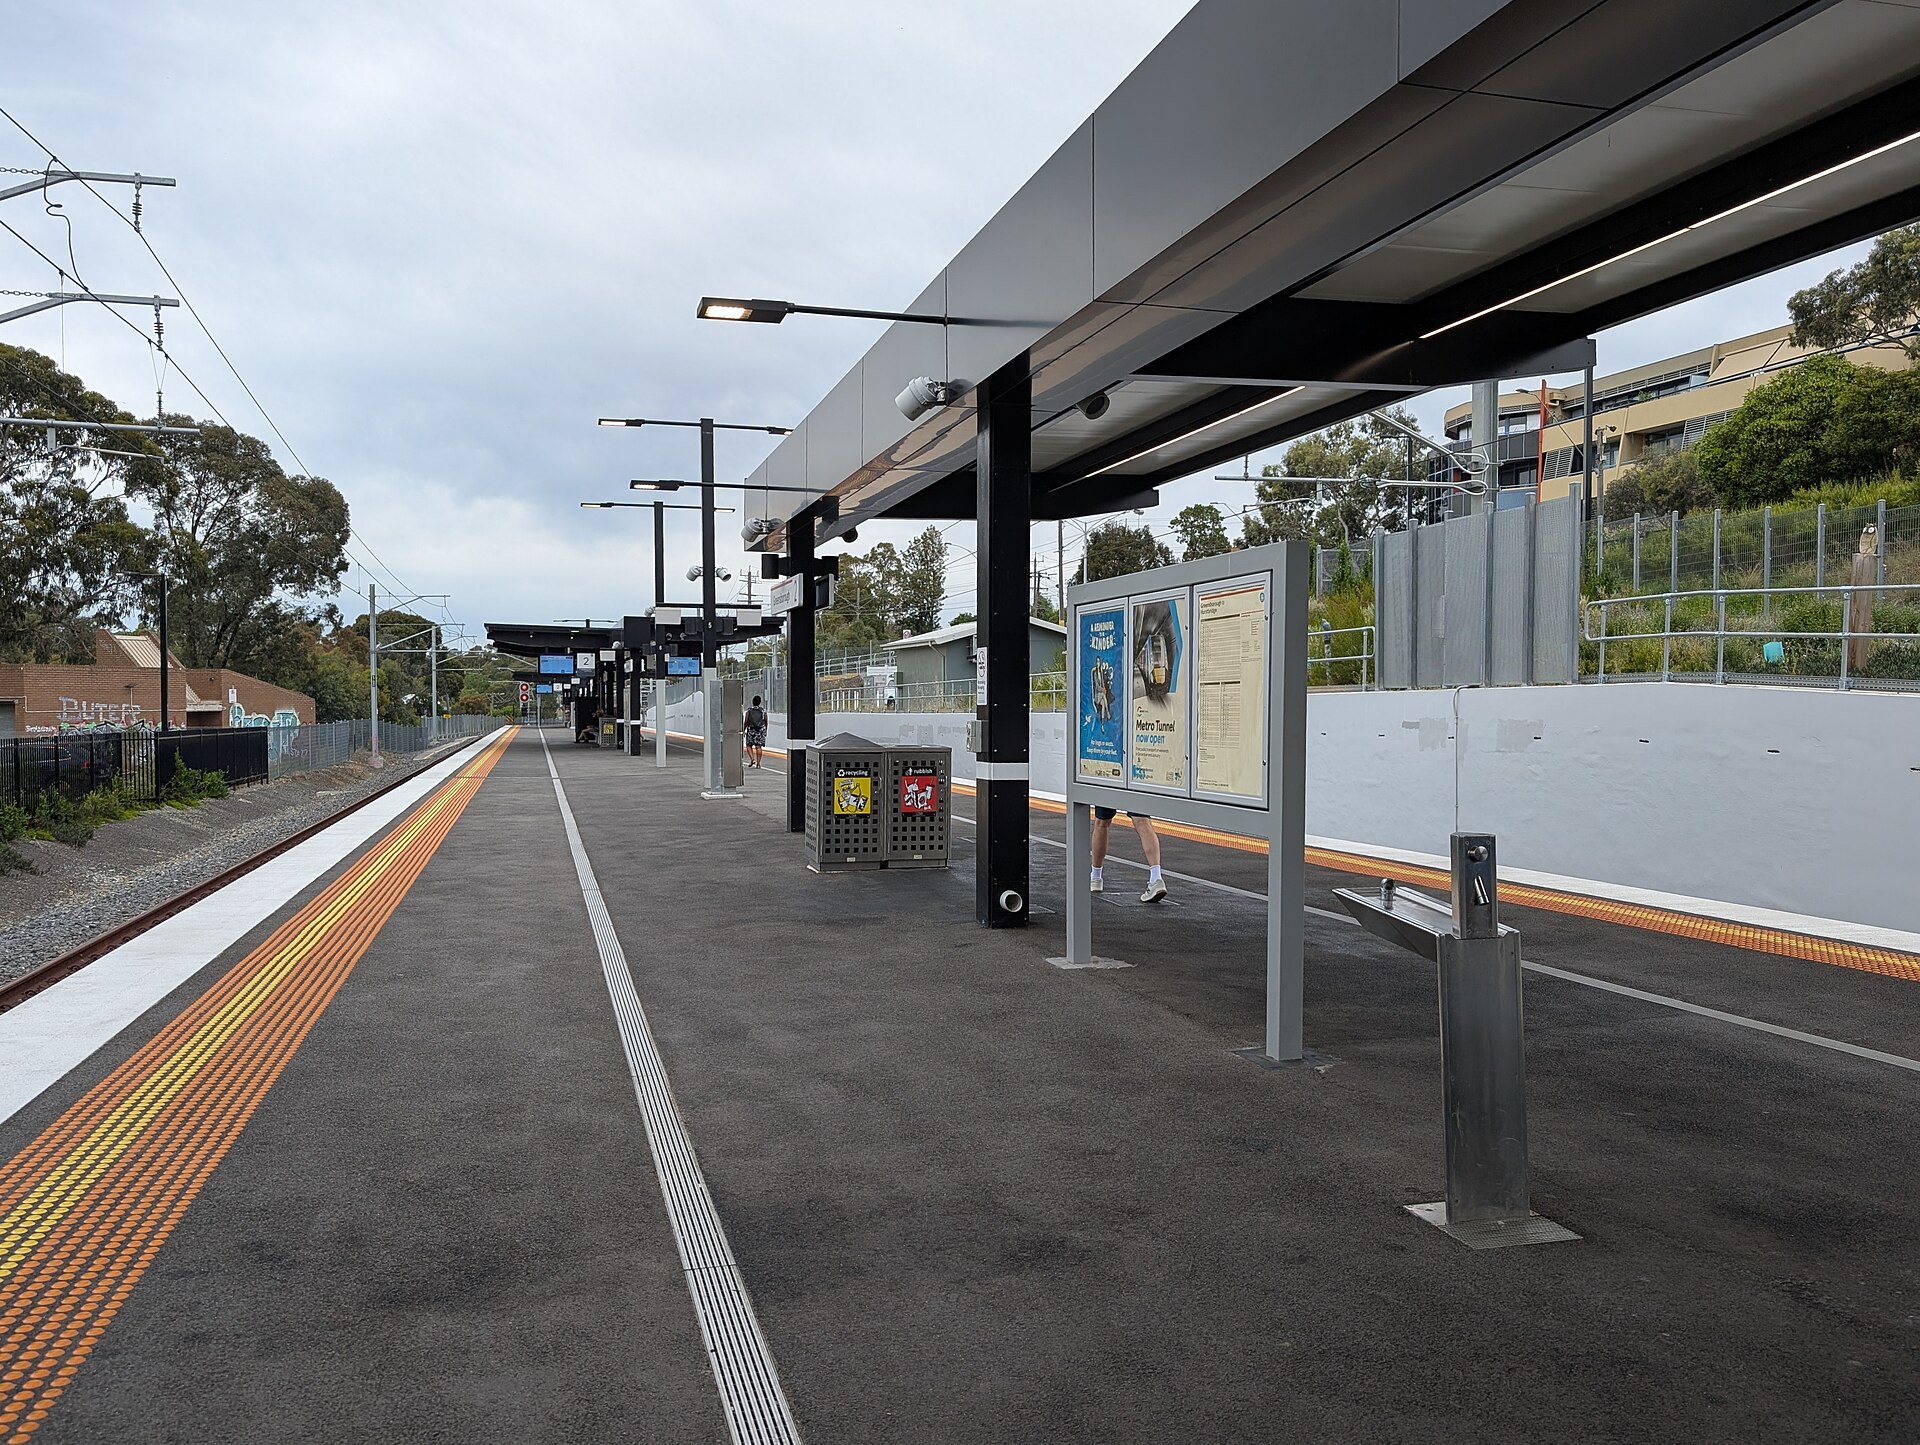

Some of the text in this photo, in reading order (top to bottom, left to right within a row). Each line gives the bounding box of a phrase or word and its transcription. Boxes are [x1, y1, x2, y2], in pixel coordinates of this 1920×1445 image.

[794, 580, 797, 602] 2
[1092, 634, 1113, 651] KINDER
[583, 657, 589, 665] 2
[1136, 719, 1175, 732] Metro Tunnel
[1136, 734, 1165, 747] now open
